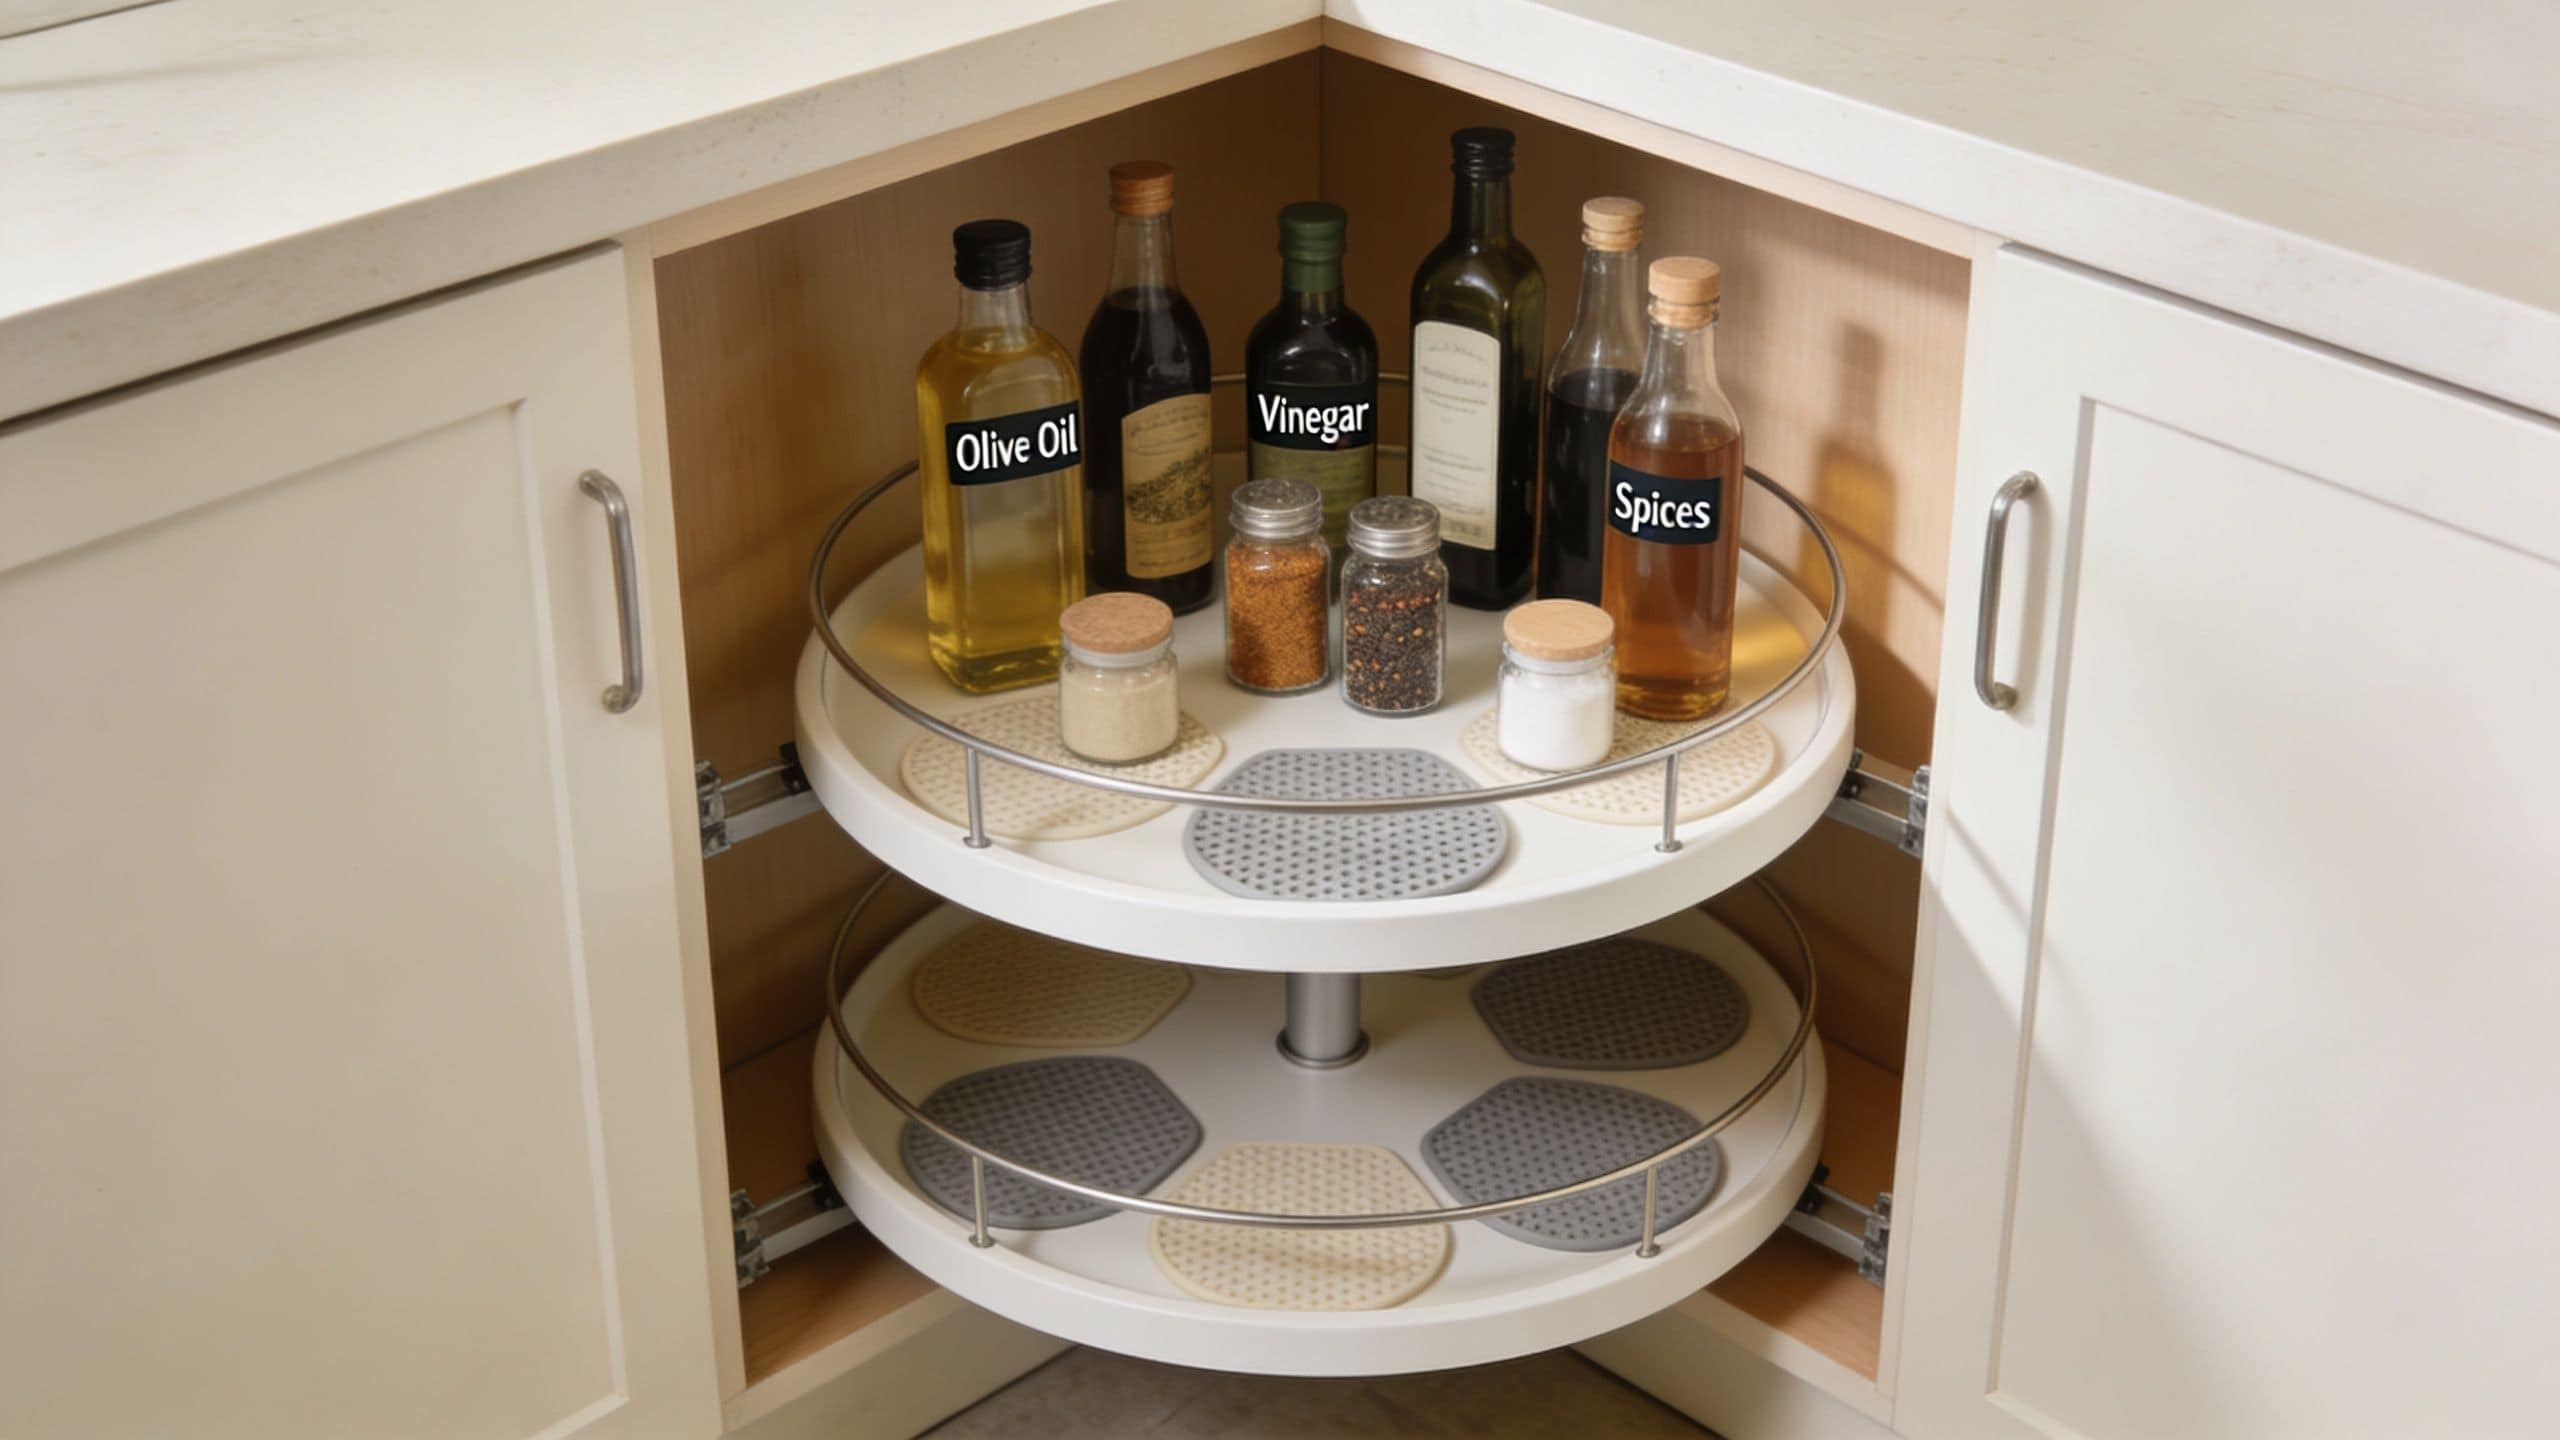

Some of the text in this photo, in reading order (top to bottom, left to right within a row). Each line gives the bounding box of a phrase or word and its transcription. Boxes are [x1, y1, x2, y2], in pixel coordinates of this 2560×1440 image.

[956, 430, 1030, 471] Olive
[1038, 413, 1078, 458] Oil
[1257, 393, 1370, 444] Vinegar
[1615, 481, 1710, 533] Spices
